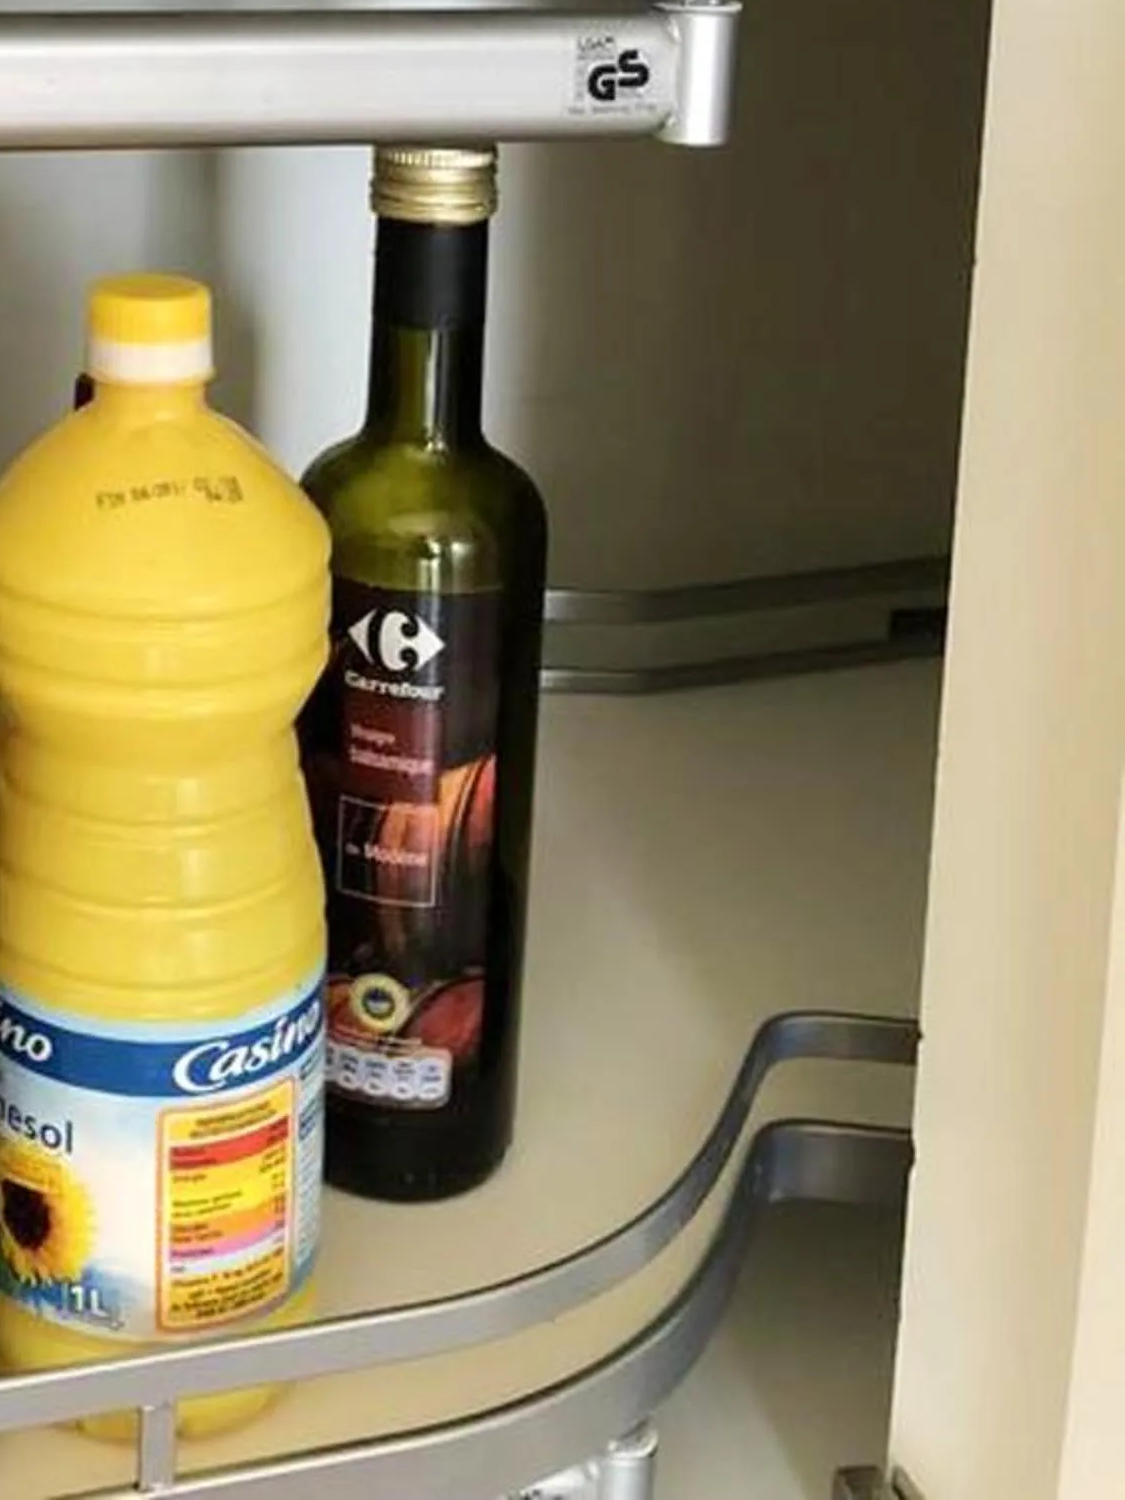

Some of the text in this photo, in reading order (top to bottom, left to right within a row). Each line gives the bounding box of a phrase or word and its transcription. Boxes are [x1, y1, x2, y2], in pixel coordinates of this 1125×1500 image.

[587, 48, 650, 102] GS
[344, 669, 445, 702] Carrefour
[172, 998, 321, 1094] Casino
